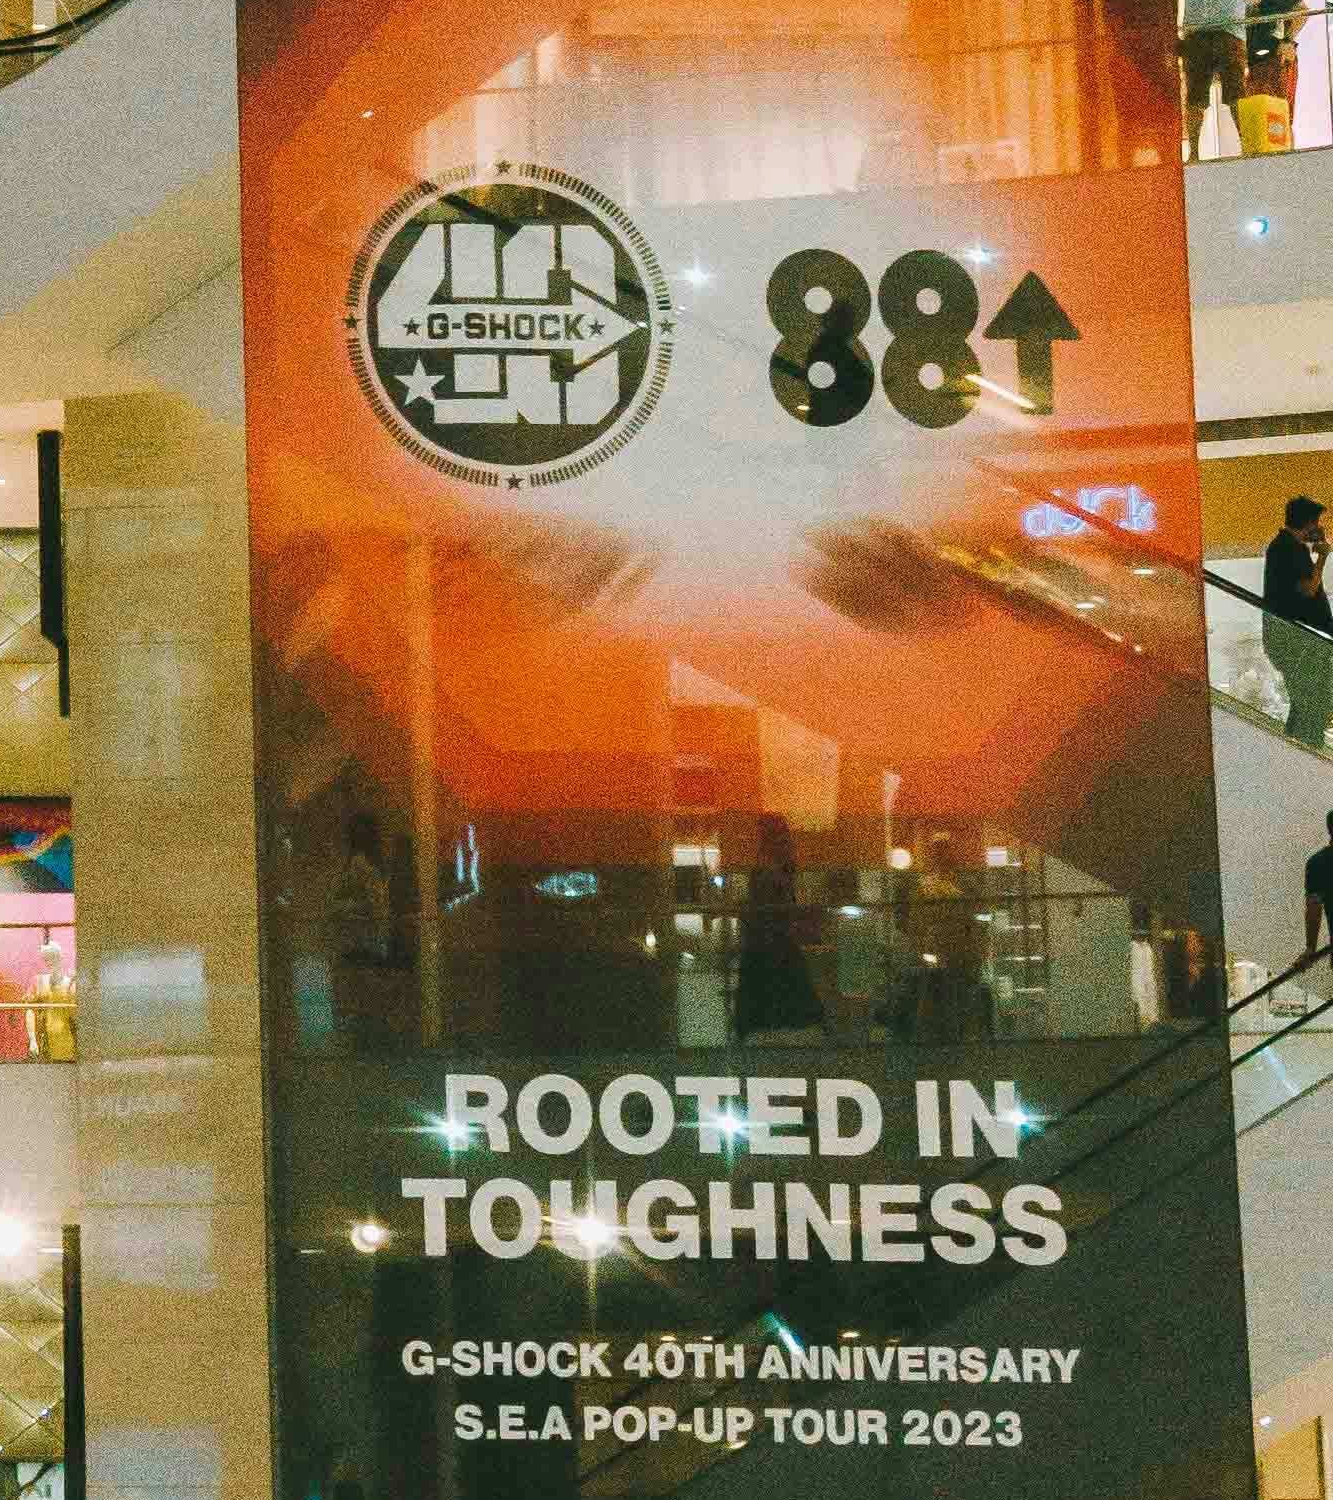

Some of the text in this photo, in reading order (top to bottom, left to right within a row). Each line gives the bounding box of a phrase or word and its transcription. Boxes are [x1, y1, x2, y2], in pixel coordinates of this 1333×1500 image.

[427, 312, 586, 342] G-SHOCK
[444, 1074, 1018, 1158] ROOTED IN
[402, 1177, 1067, 1265] TOUGHNESS
[403, 1341, 1080, 1383] G-SHOCK 40TH ANNIVERSARY
[454, 1405, 1023, 1447] S.E.A POP-UP TOUR 2023
